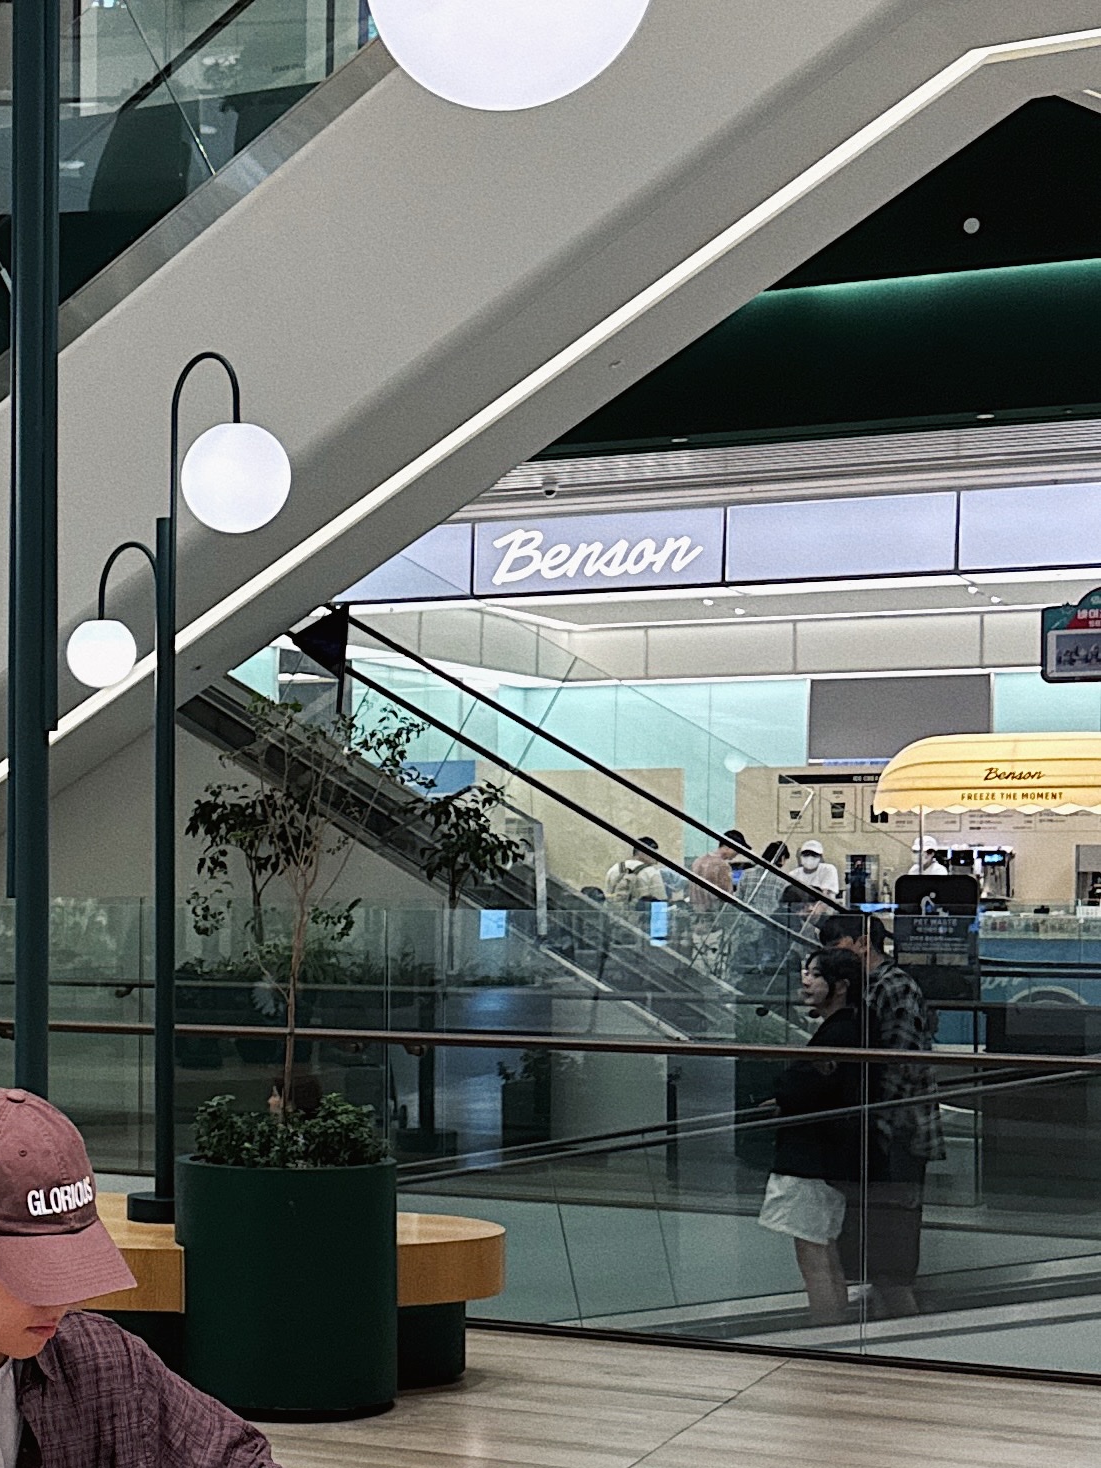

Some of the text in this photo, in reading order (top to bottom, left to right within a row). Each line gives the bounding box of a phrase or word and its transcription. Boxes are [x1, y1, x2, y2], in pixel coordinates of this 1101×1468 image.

[492, 528, 704, 586] Benson
[983, 767, 1046, 781] Benson
[961, 791, 1064, 801] FREEZE THE MOMENT
[27, 1176, 94, 1217] GLORIOUS
